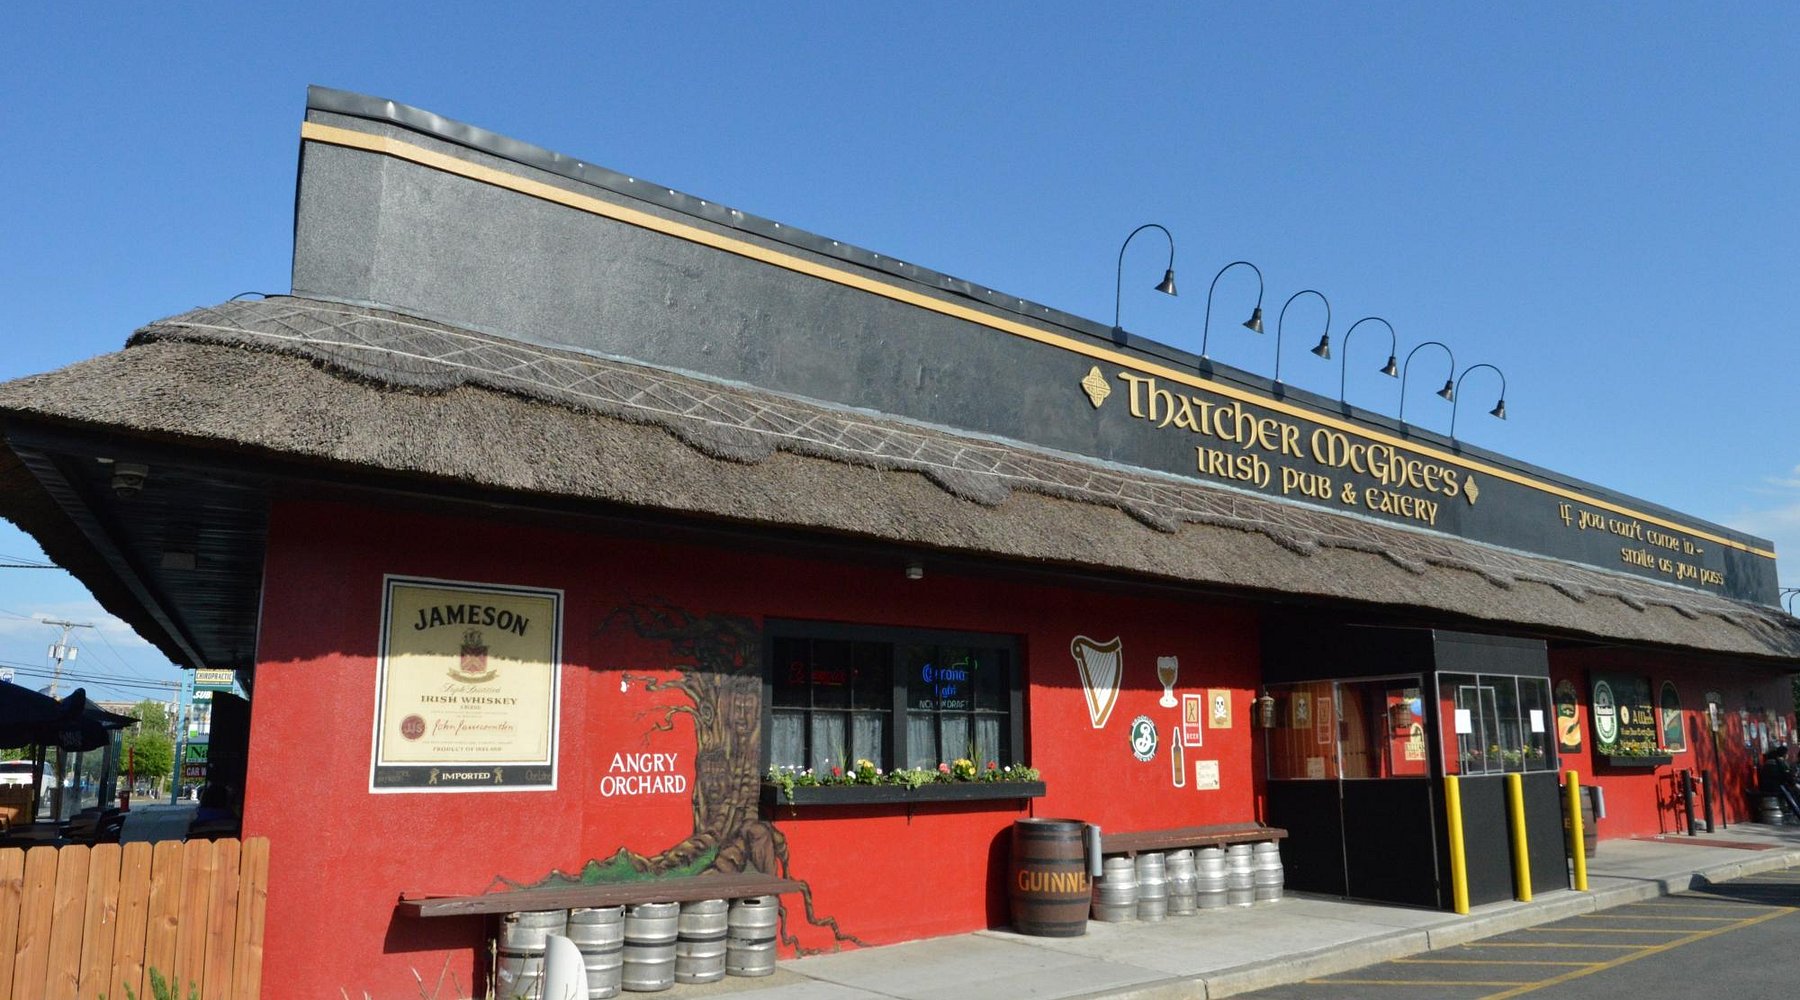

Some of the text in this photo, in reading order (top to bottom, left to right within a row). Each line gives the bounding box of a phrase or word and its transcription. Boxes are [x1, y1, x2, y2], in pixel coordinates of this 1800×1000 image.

[1341, 482, 1358, 505] &
[1579, 509, 1605, 530] you
[1609, 518, 1643, 541] can't
[1646, 529, 1680, 551] come
[1621, 547, 1724, 586] smile as you pass
[414, 604, 529, 637] JAMESON
[420, 695, 518, 705] IRISH WHISKEY
[608, 752, 678, 773] ANGRY
[442, 772, 490, 781] IMPORTED
[600, 774, 686, 798] ORCHARD
